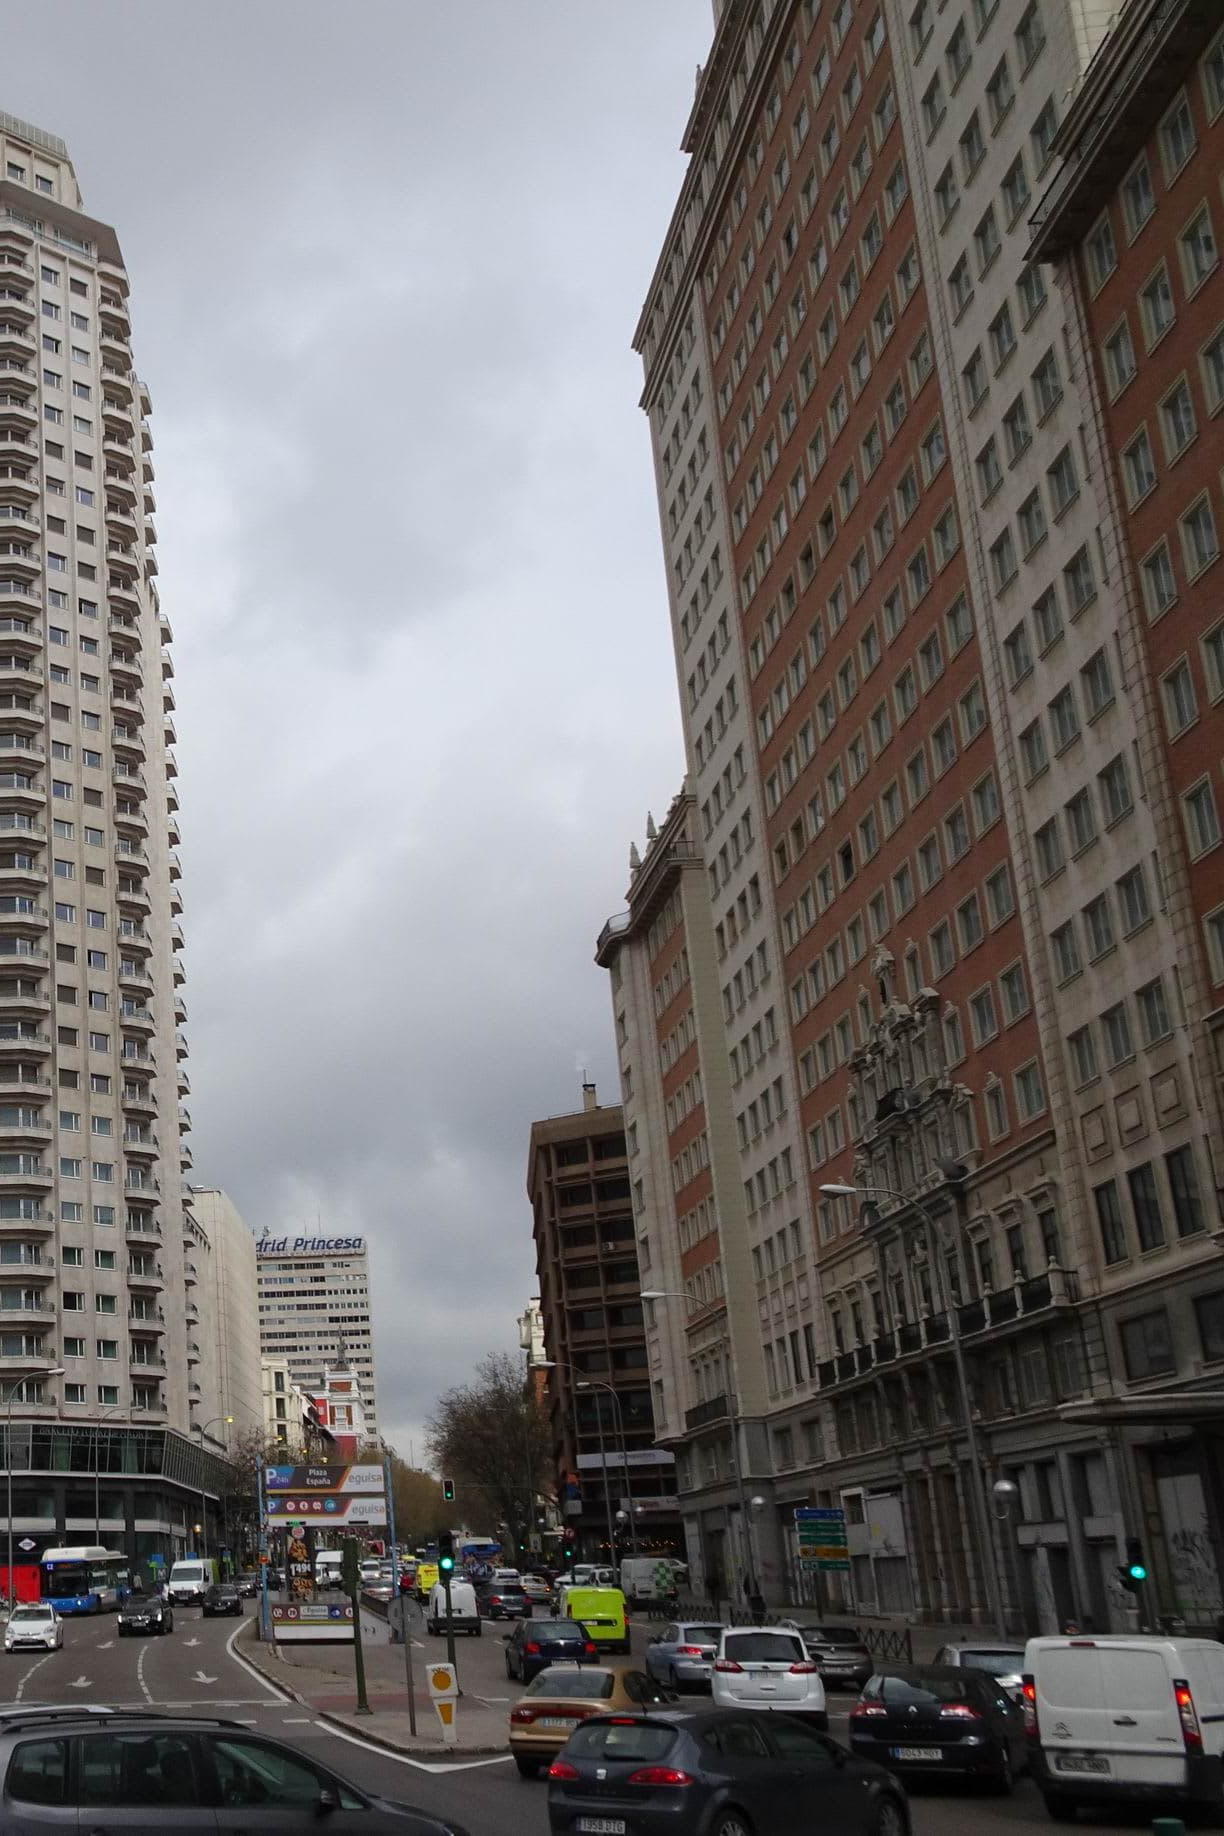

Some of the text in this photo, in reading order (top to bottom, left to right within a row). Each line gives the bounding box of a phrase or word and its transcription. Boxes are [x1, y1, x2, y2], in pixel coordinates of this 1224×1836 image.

[293, 1237, 362, 1251] Princesa
[308, 1469, 328, 1477] Plaza
[306, 1478, 331, 1486] España
